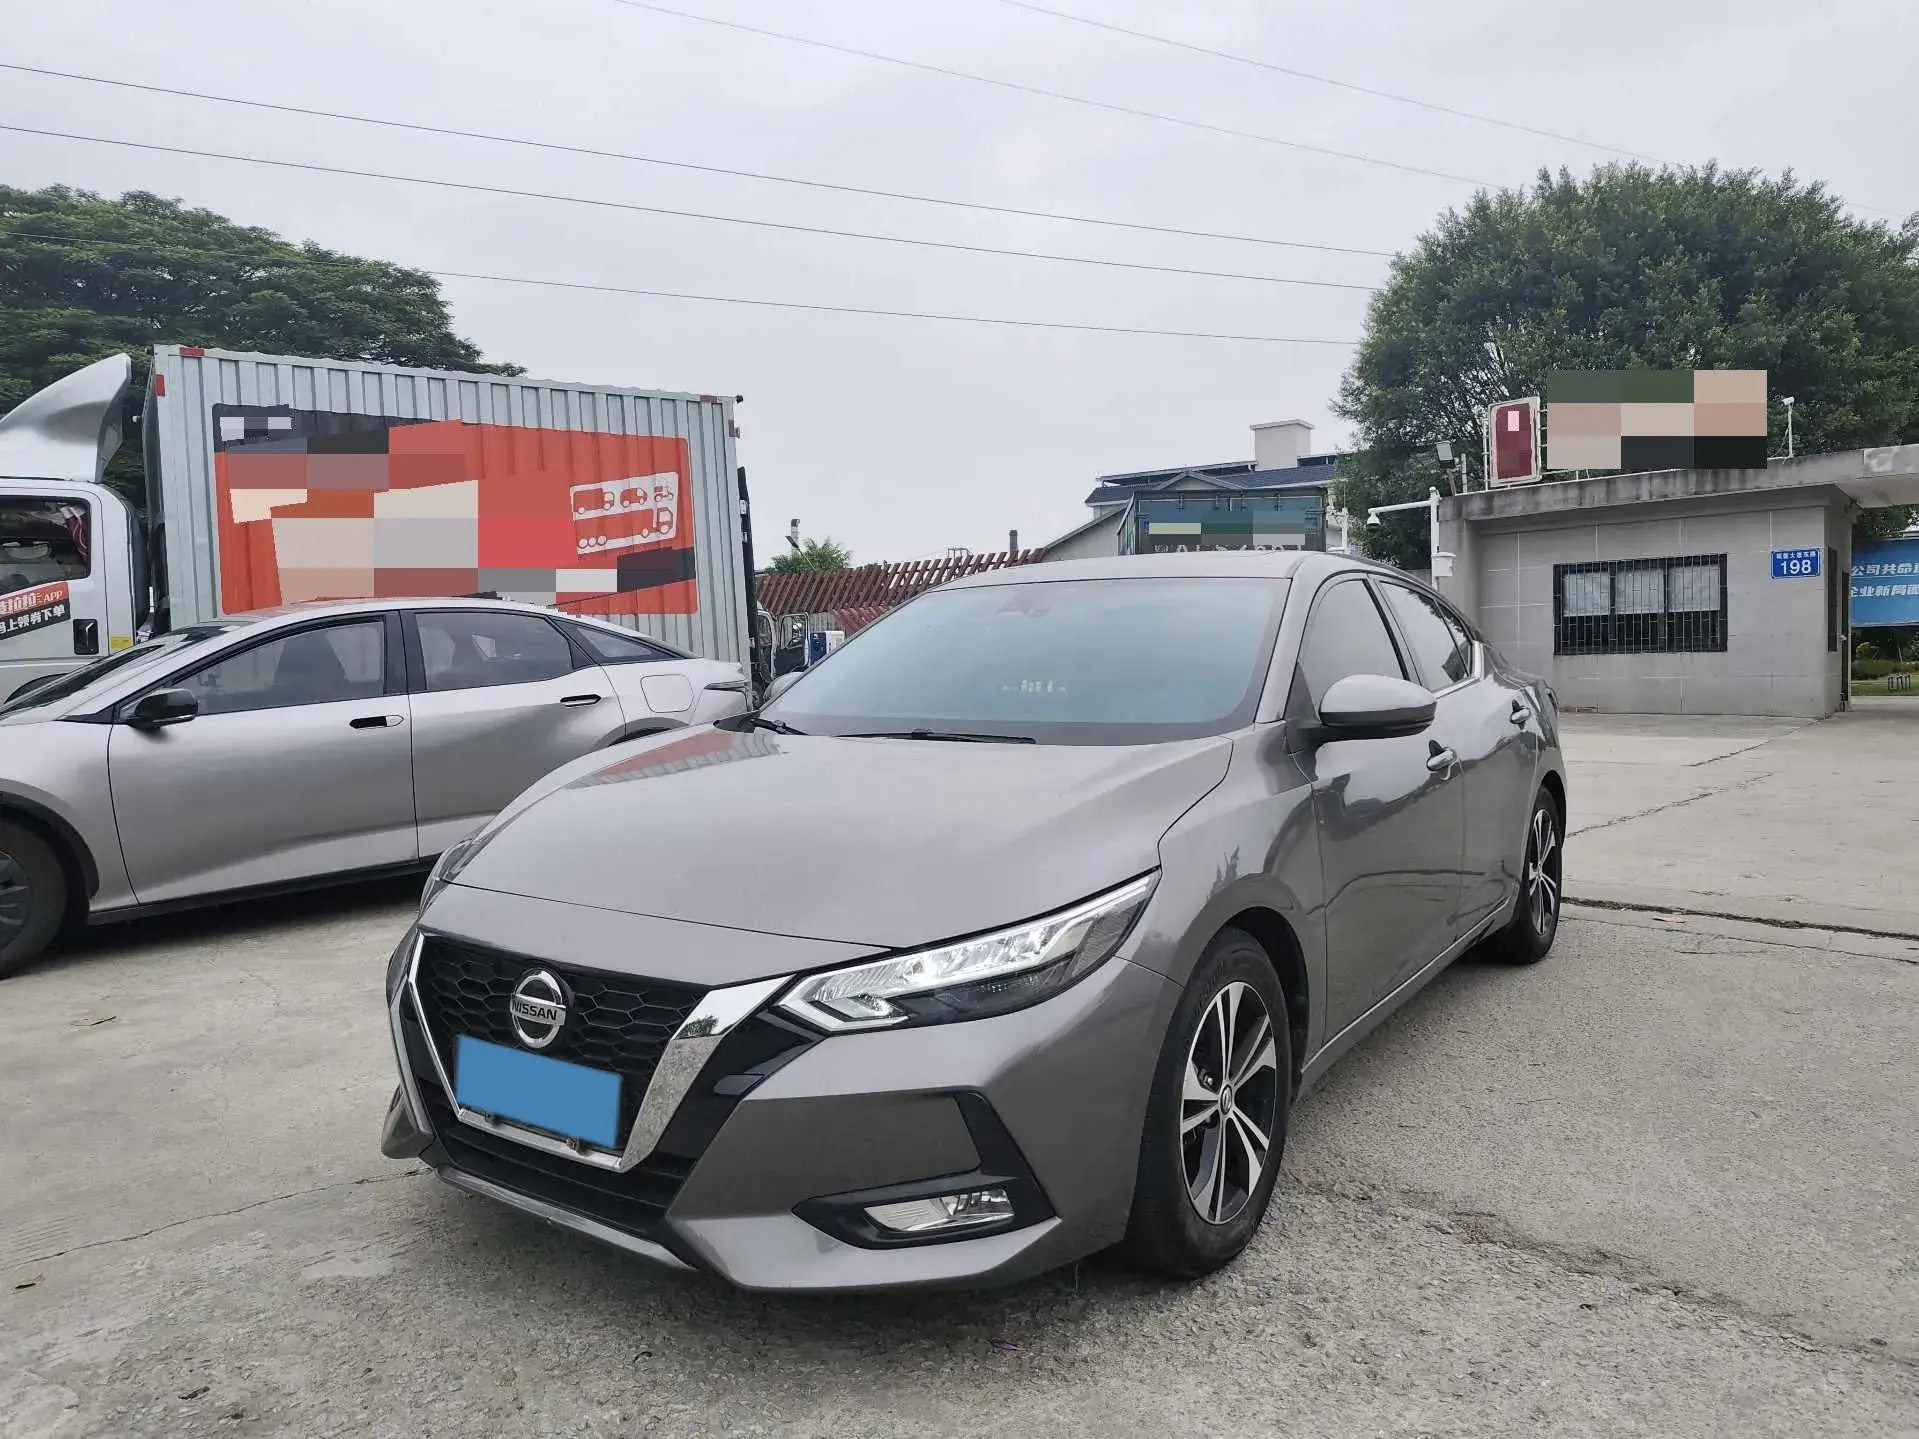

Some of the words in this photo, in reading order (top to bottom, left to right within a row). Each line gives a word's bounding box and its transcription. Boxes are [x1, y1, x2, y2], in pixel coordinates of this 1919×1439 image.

[1780, 559, 1812, 575] 198
[44, 590, 63, 602] APP
[512, 1000, 557, 1021] NISSAN
